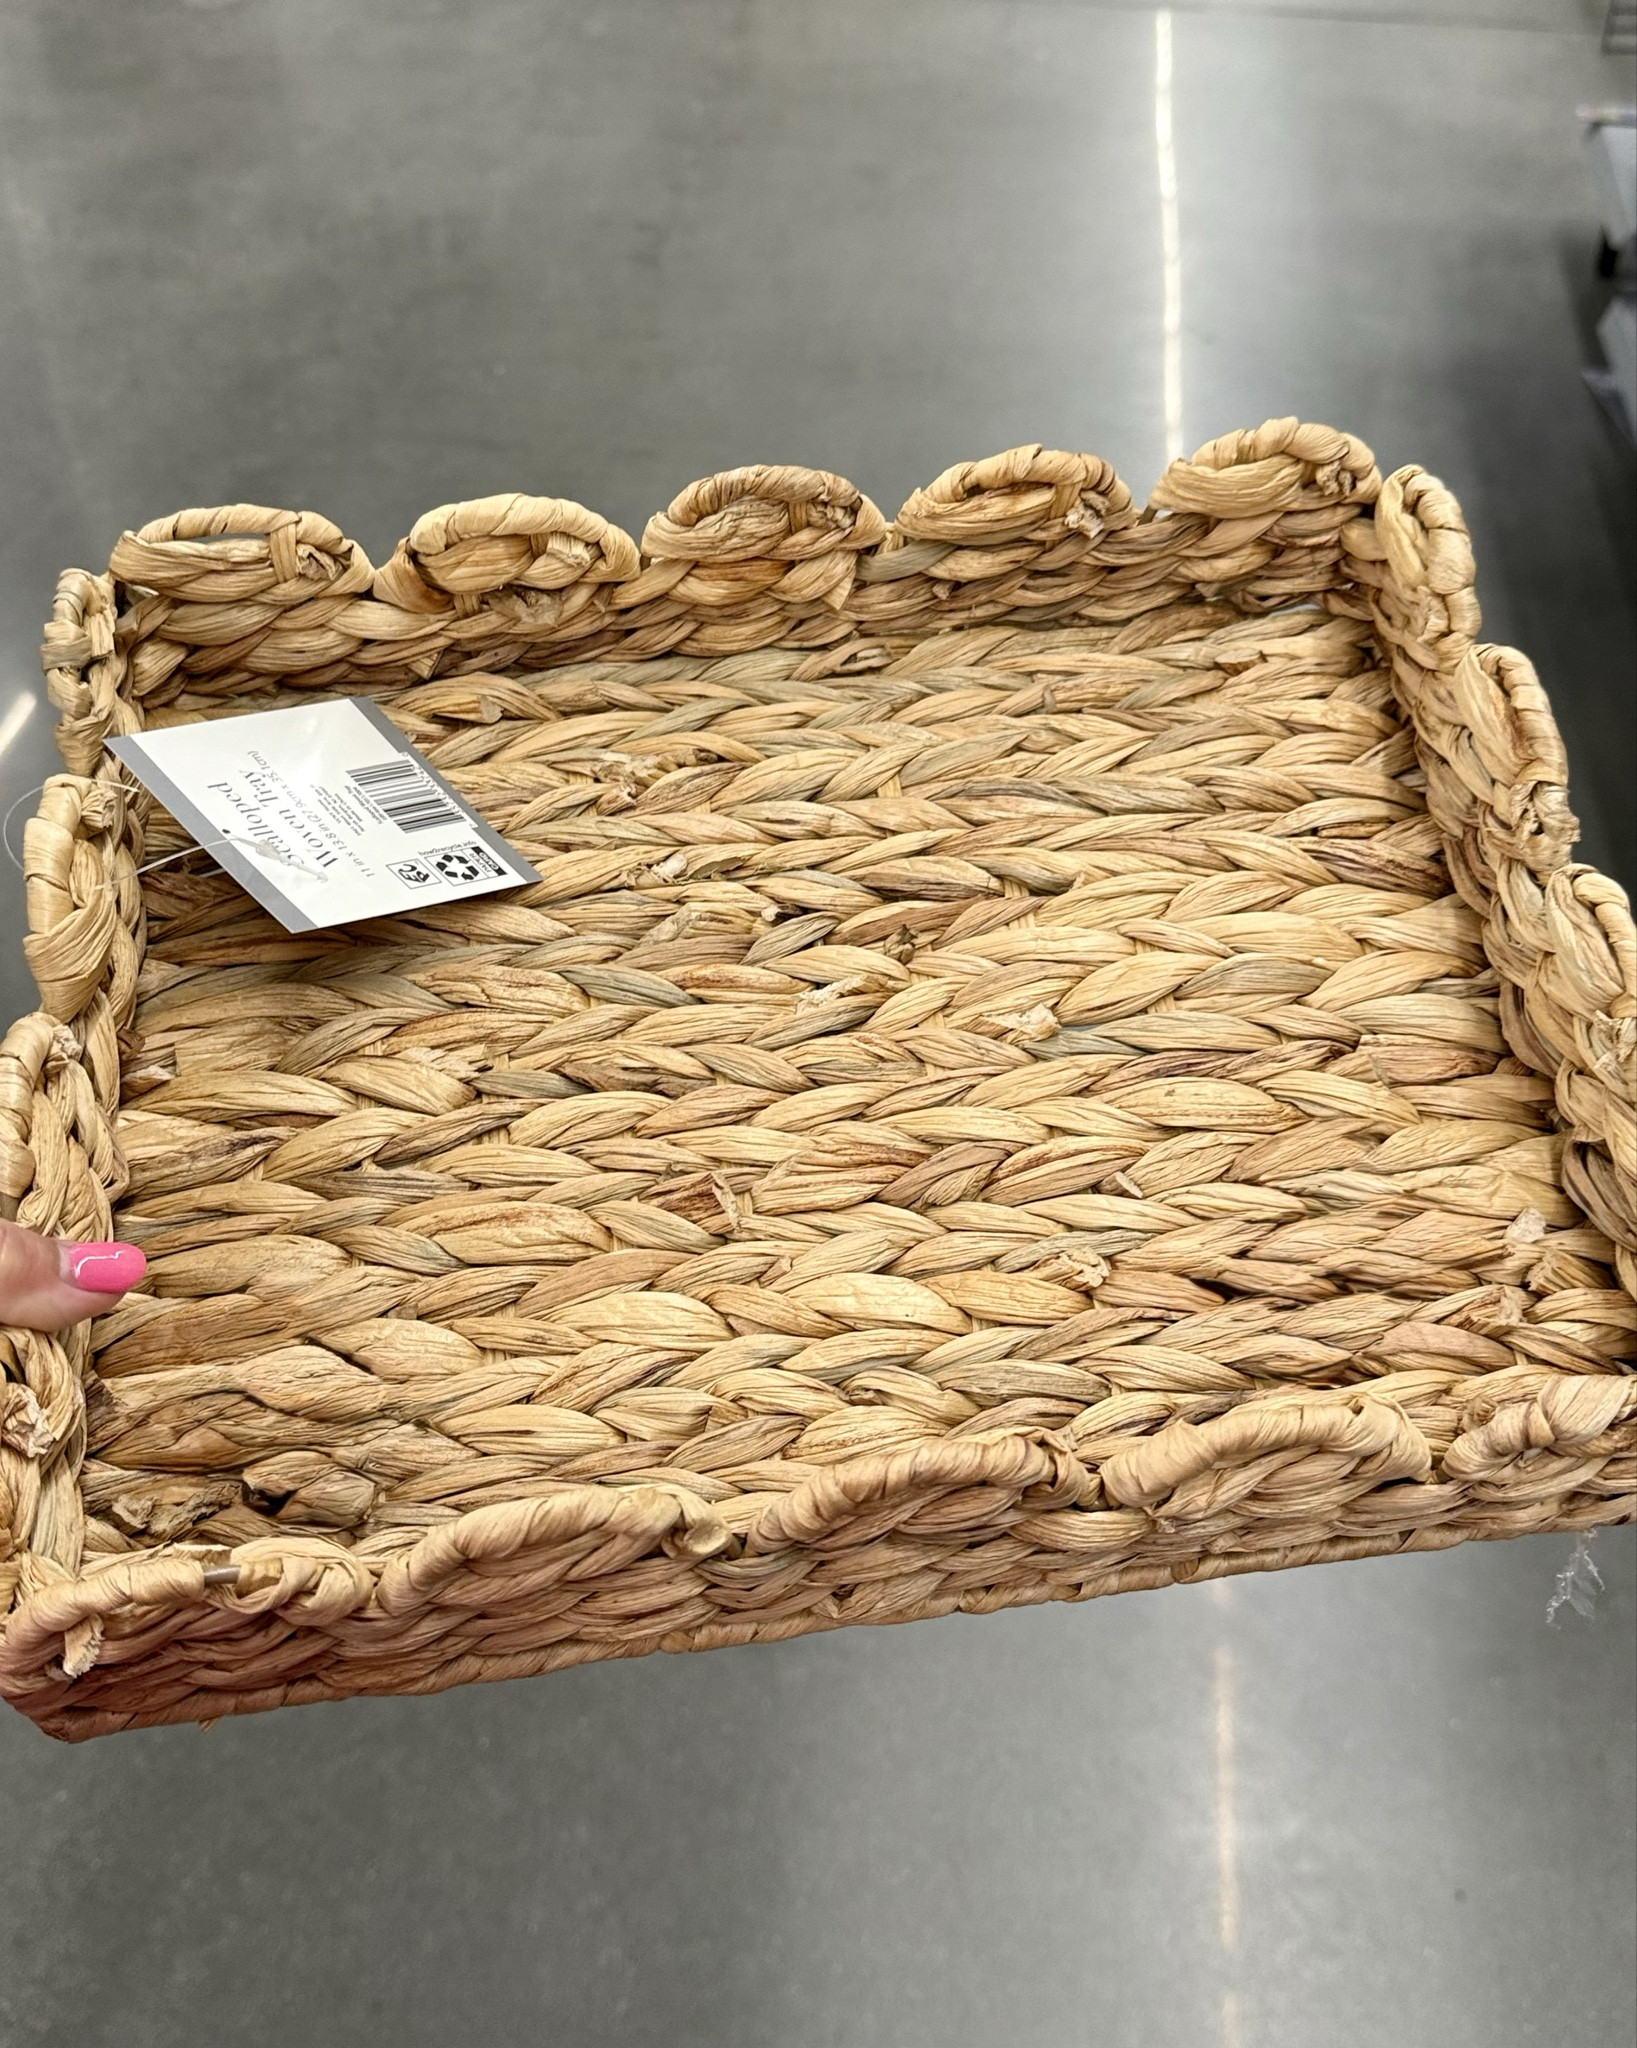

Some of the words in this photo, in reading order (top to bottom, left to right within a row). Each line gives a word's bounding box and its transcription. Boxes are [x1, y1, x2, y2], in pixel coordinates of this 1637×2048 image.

[239, 770, 279, 808] Tray
[286, 790, 322, 823] (279cm
[207, 782, 305, 867] Scalloped
[279, 809, 339, 868] Woven
[360, 868, 375, 877] 11
[479, 851, 499, 871] CARD
